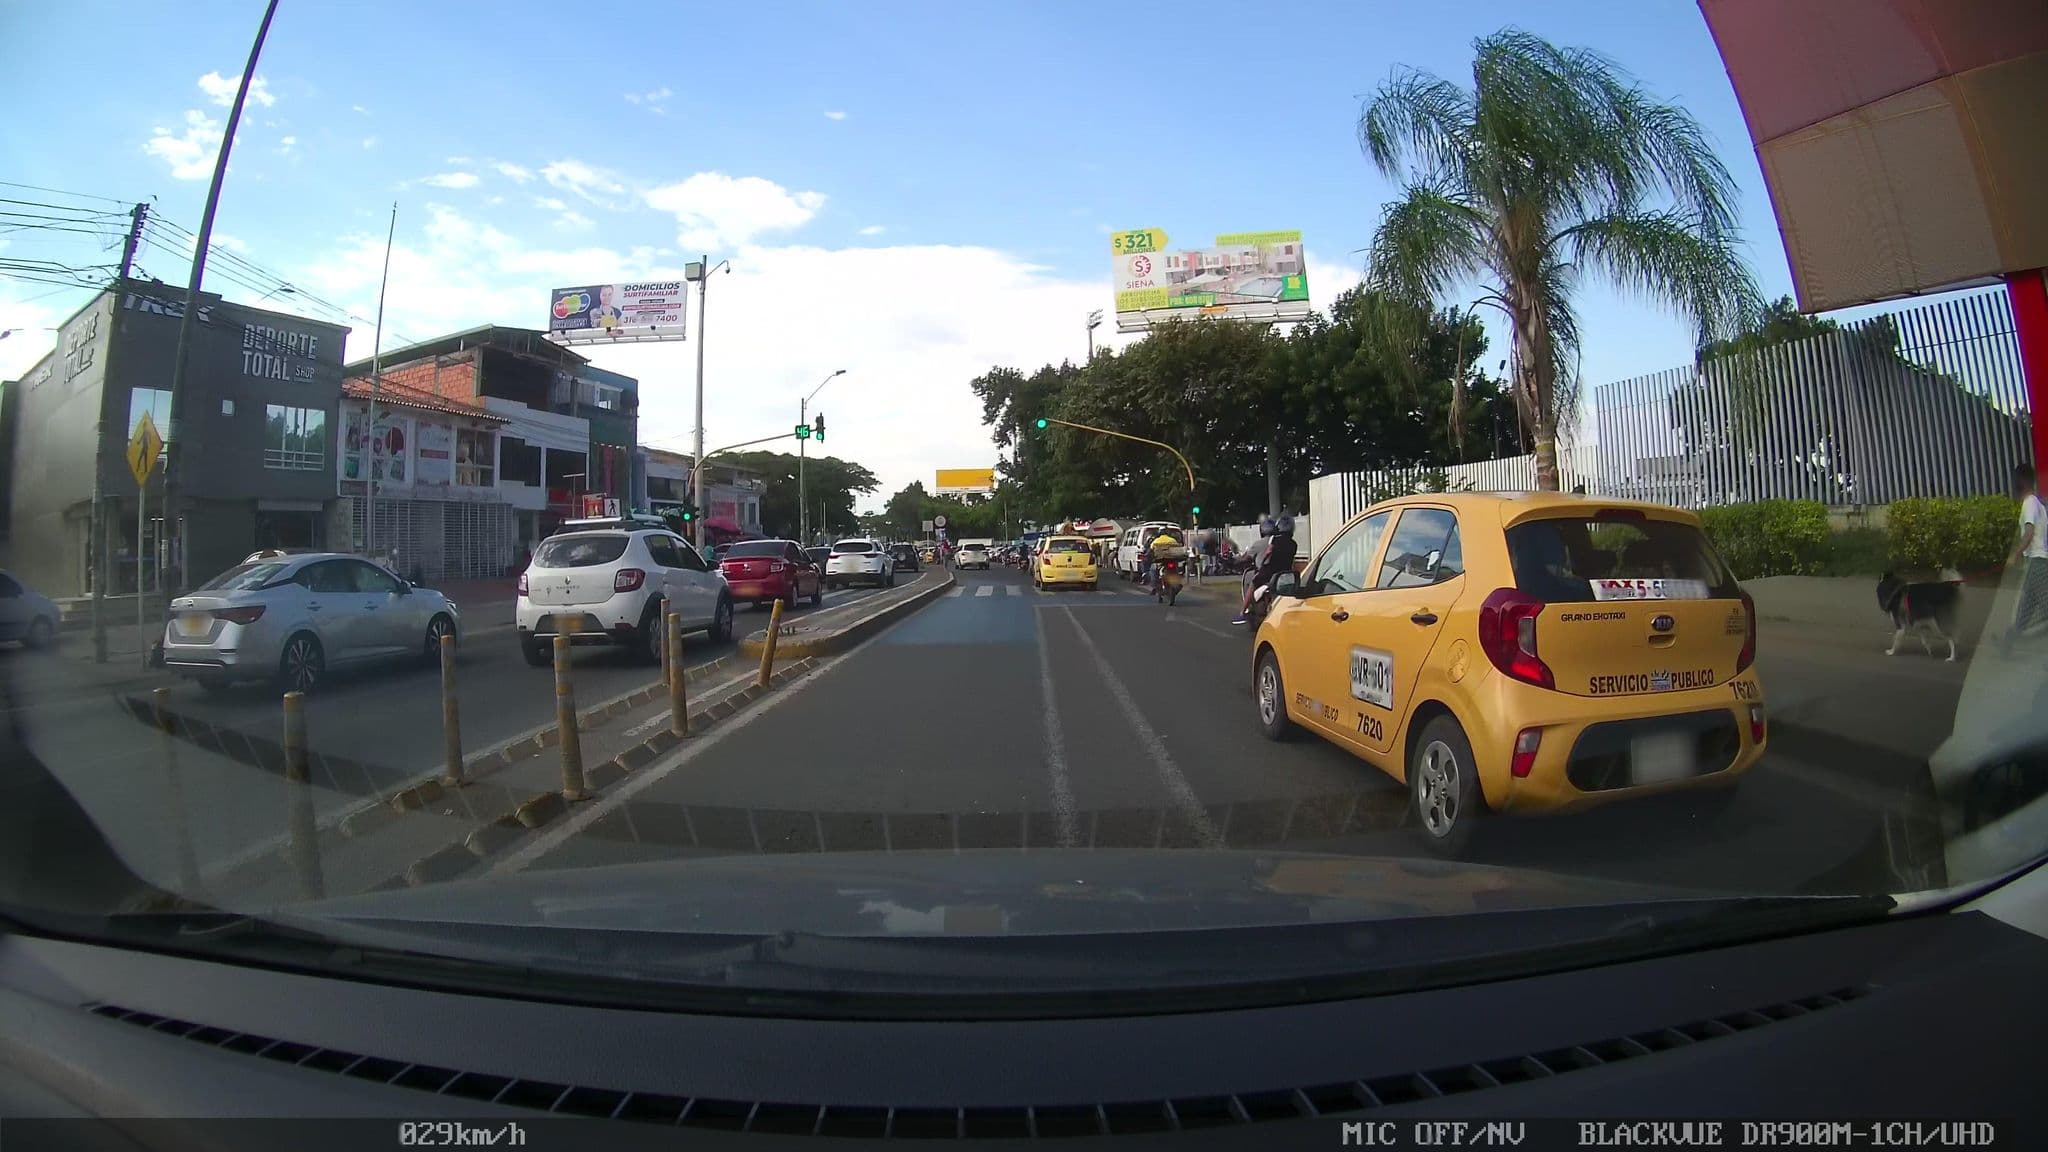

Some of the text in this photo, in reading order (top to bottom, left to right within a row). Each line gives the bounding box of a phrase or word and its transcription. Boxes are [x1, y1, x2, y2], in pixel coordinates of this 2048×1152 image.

[1125, 233, 1153, 248] 321
[624, 282, 680, 291] DOMICILIOS
[1126, 280, 1155, 288] SIENA
[623, 290, 679, 298] SURTIFAMILIAR
[243, 323, 318, 360] DEPORTE
[242, 350, 315, 381] TOTAL SHOP
[1561, 613, 1592, 622] GRAND
[1590, 668, 1714, 694] SERVICIO PUBLICO
[1357, 712, 1383, 741] 7620
